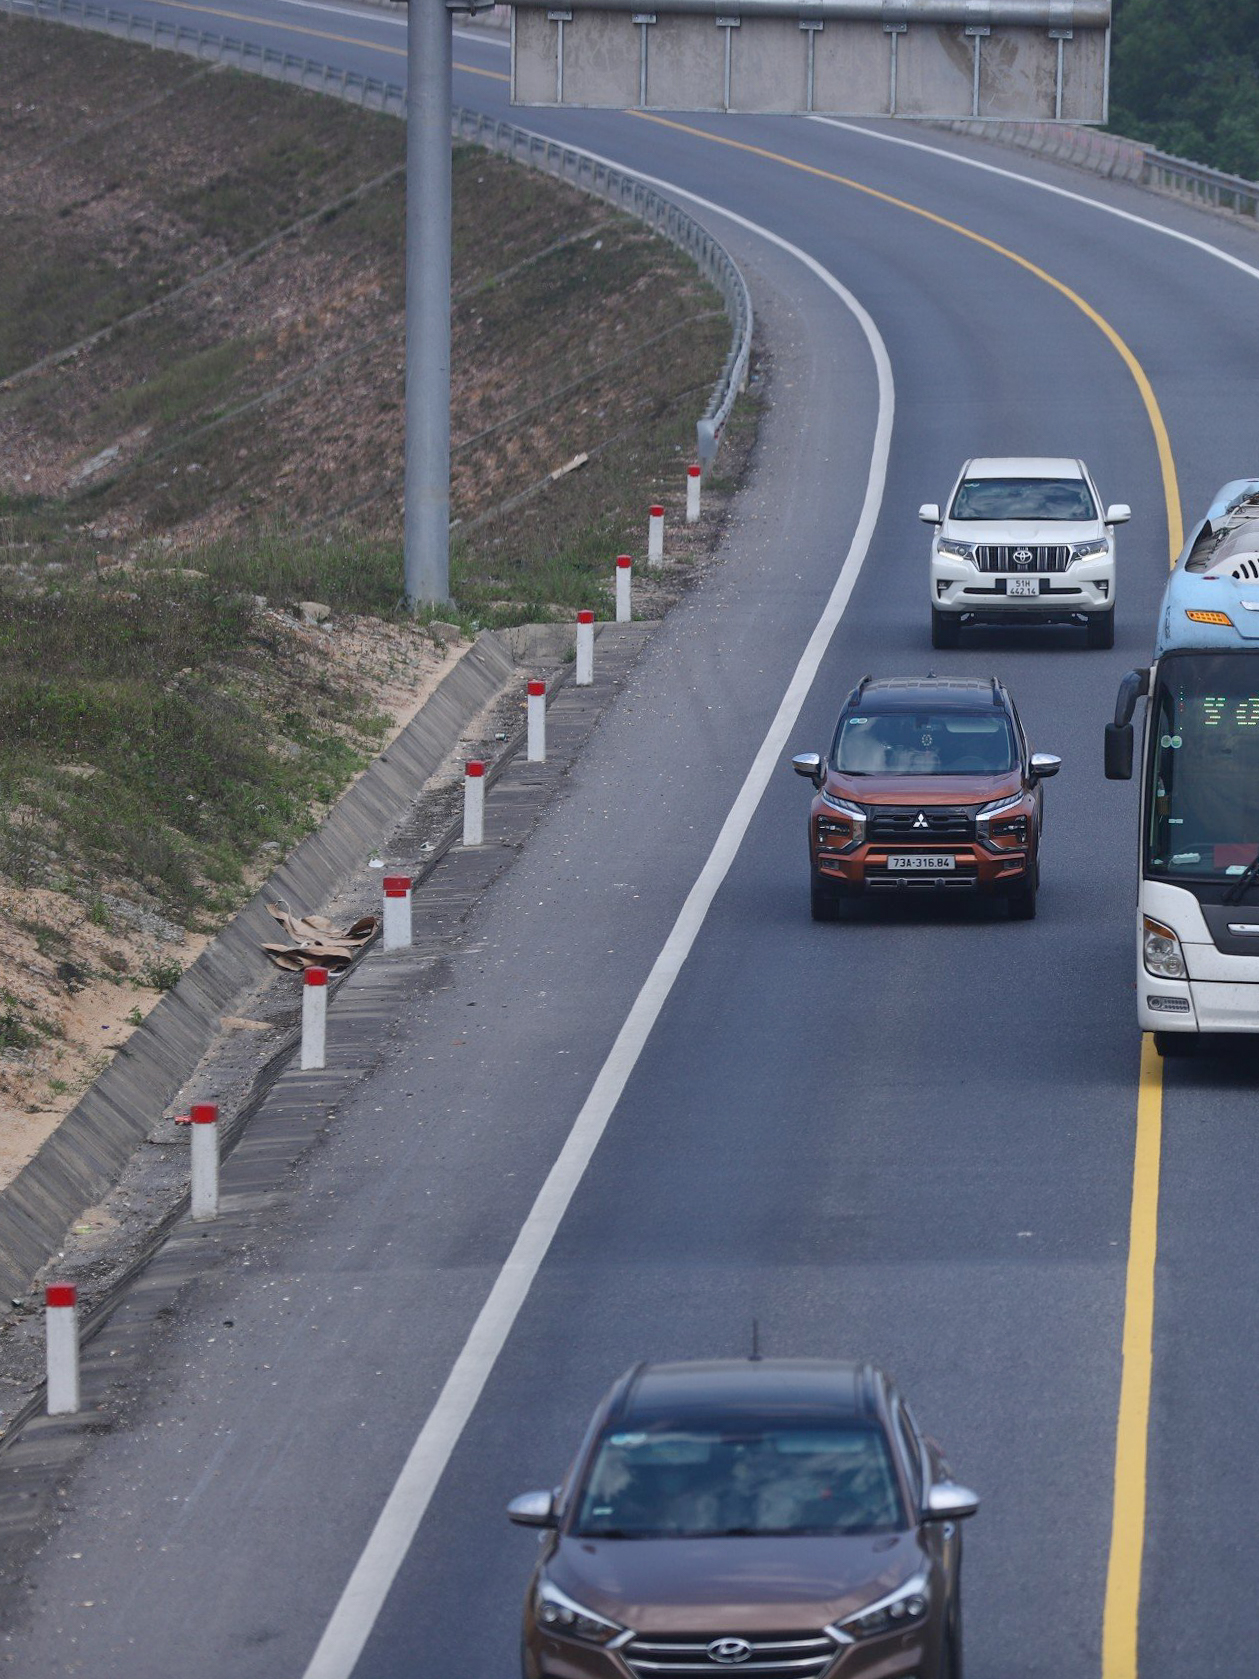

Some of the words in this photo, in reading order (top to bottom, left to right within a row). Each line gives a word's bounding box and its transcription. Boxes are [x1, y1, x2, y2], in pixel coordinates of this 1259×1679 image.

[1015, 580, 1031, 588] 51H
[1009, 587, 1037, 596] 442.14
[893, 857, 950, 868] 73A-316.84
